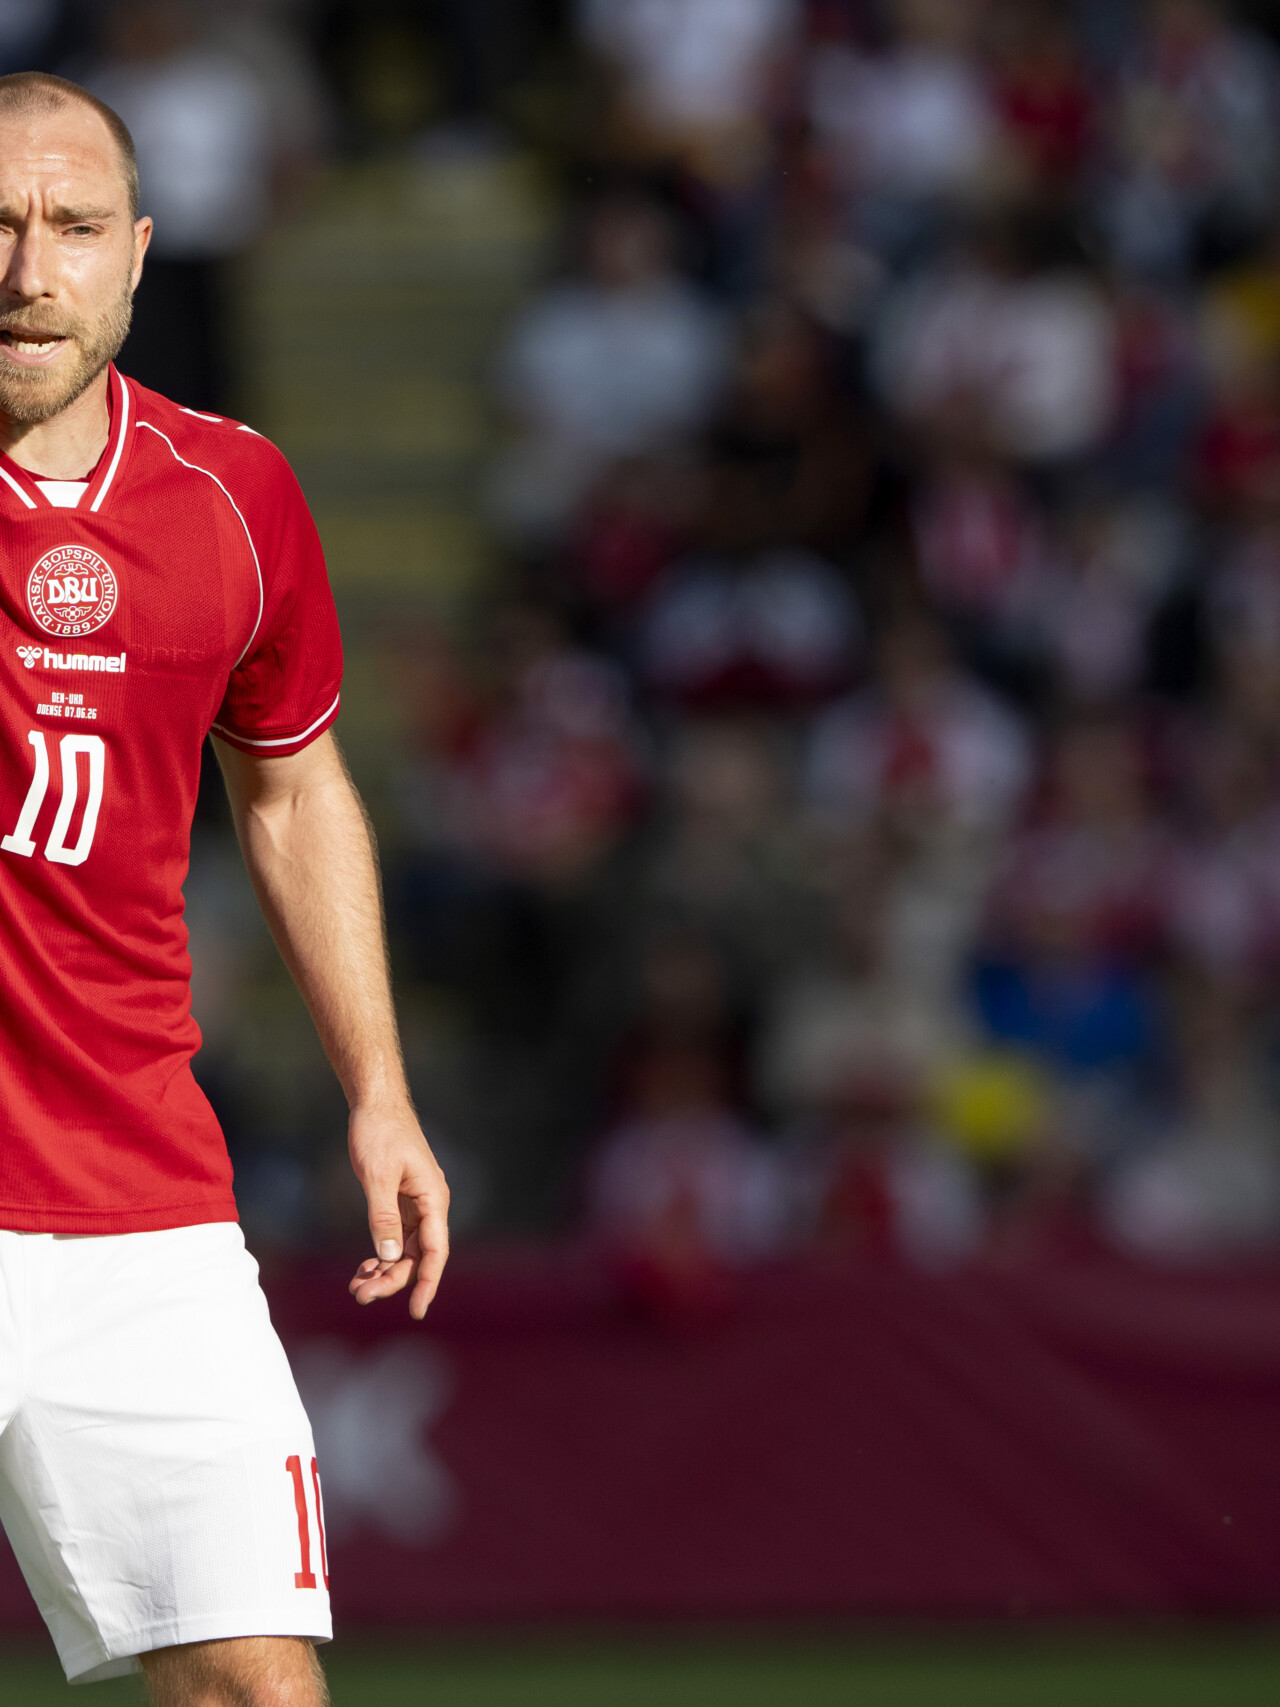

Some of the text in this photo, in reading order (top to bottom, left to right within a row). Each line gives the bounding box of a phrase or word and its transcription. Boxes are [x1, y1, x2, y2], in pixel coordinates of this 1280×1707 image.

[46, 576, 99, 604] DBU
[31, 574, 53, 627] DANSK
[55, 621, 91, 635] 1889
[43, 647, 127, 673] hummel
[36, 703, 98, 720] ODENSE 07.06.26
[51, 691, 84, 706] DEN-UKR
[0, 729, 106, 867] 10
